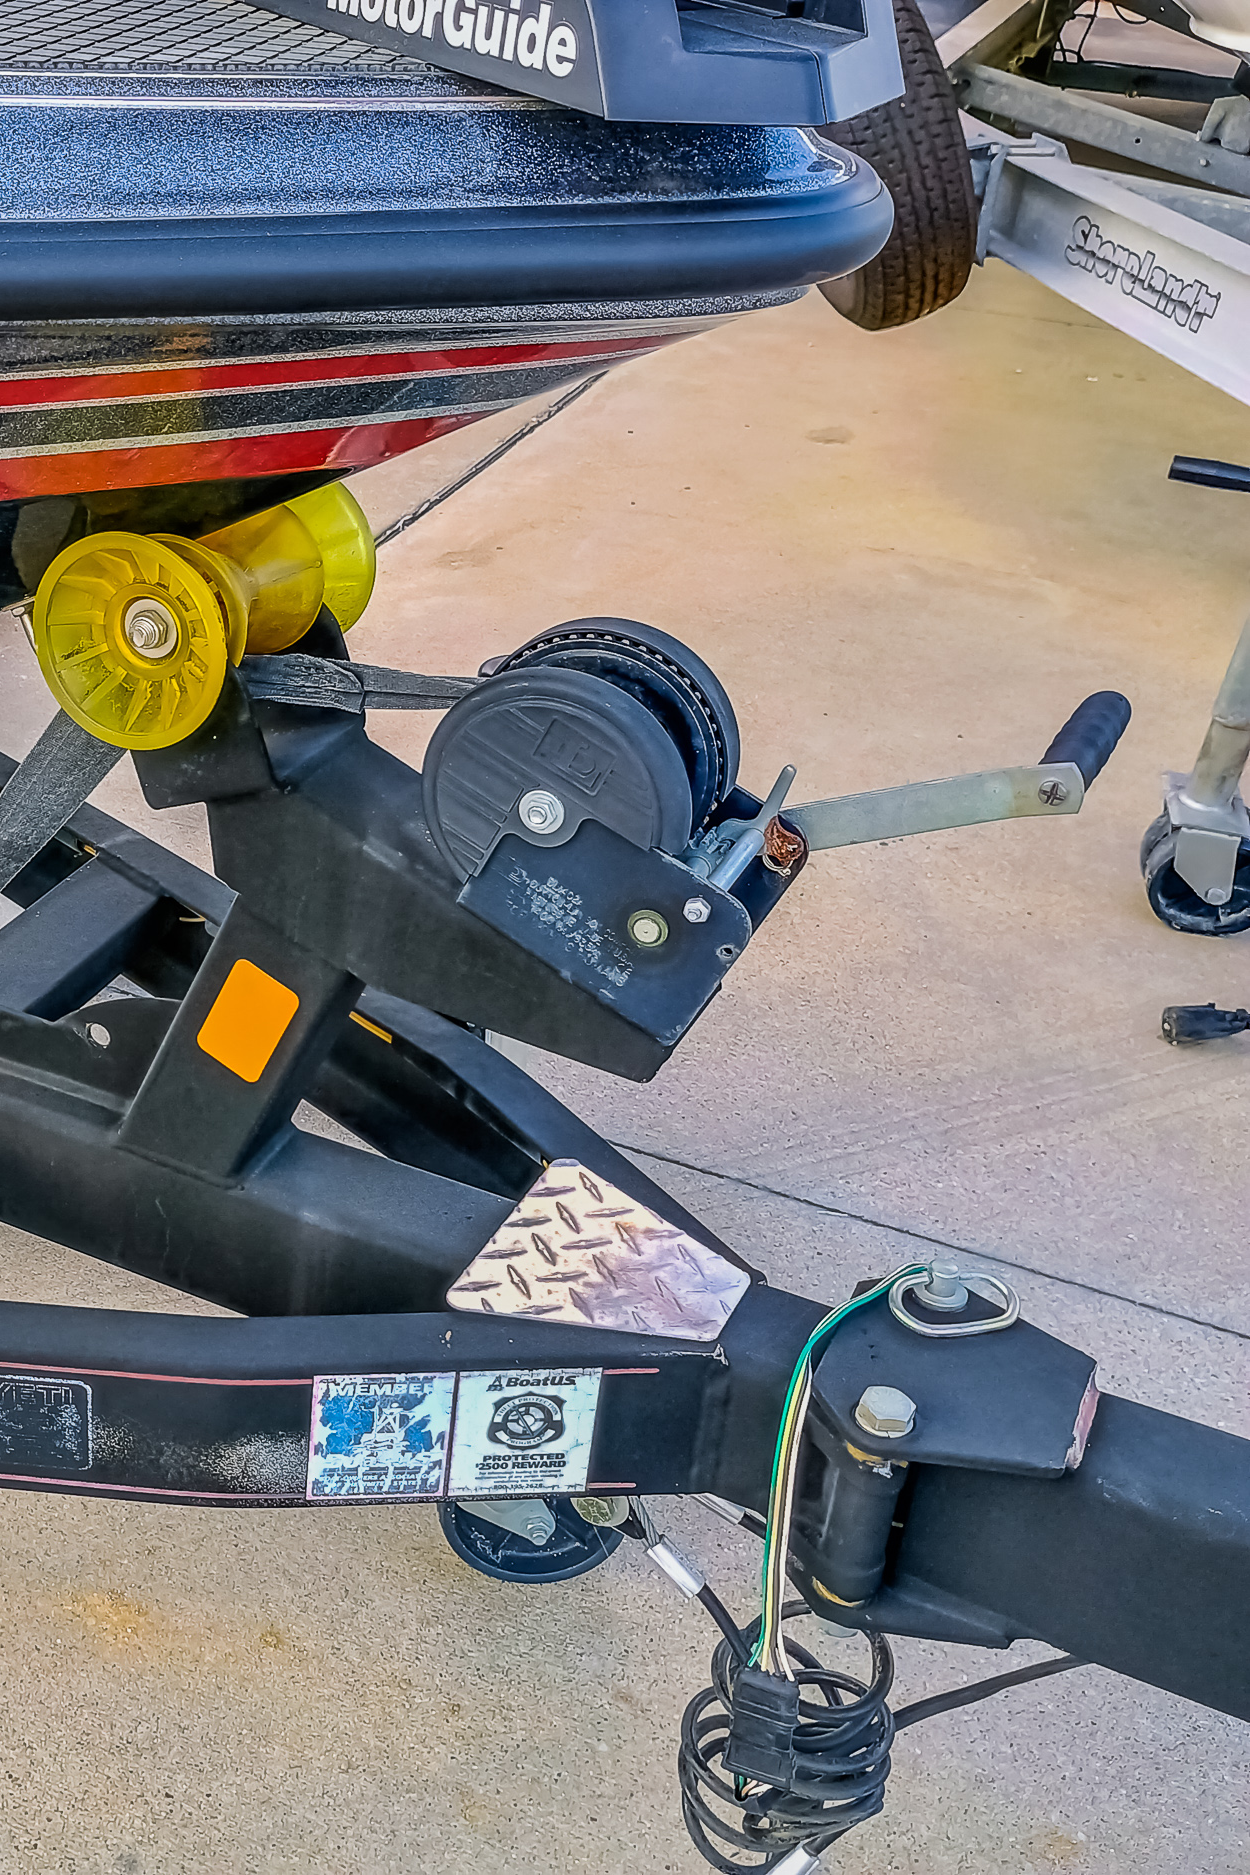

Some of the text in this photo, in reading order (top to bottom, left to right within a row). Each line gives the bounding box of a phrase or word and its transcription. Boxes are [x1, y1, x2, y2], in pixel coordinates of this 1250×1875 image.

[505, 1375, 577, 1388] BoatUS
[482, 1452, 566, 1463] PROTECTED
[475, 1460, 567, 1471] $2500 REWARD
